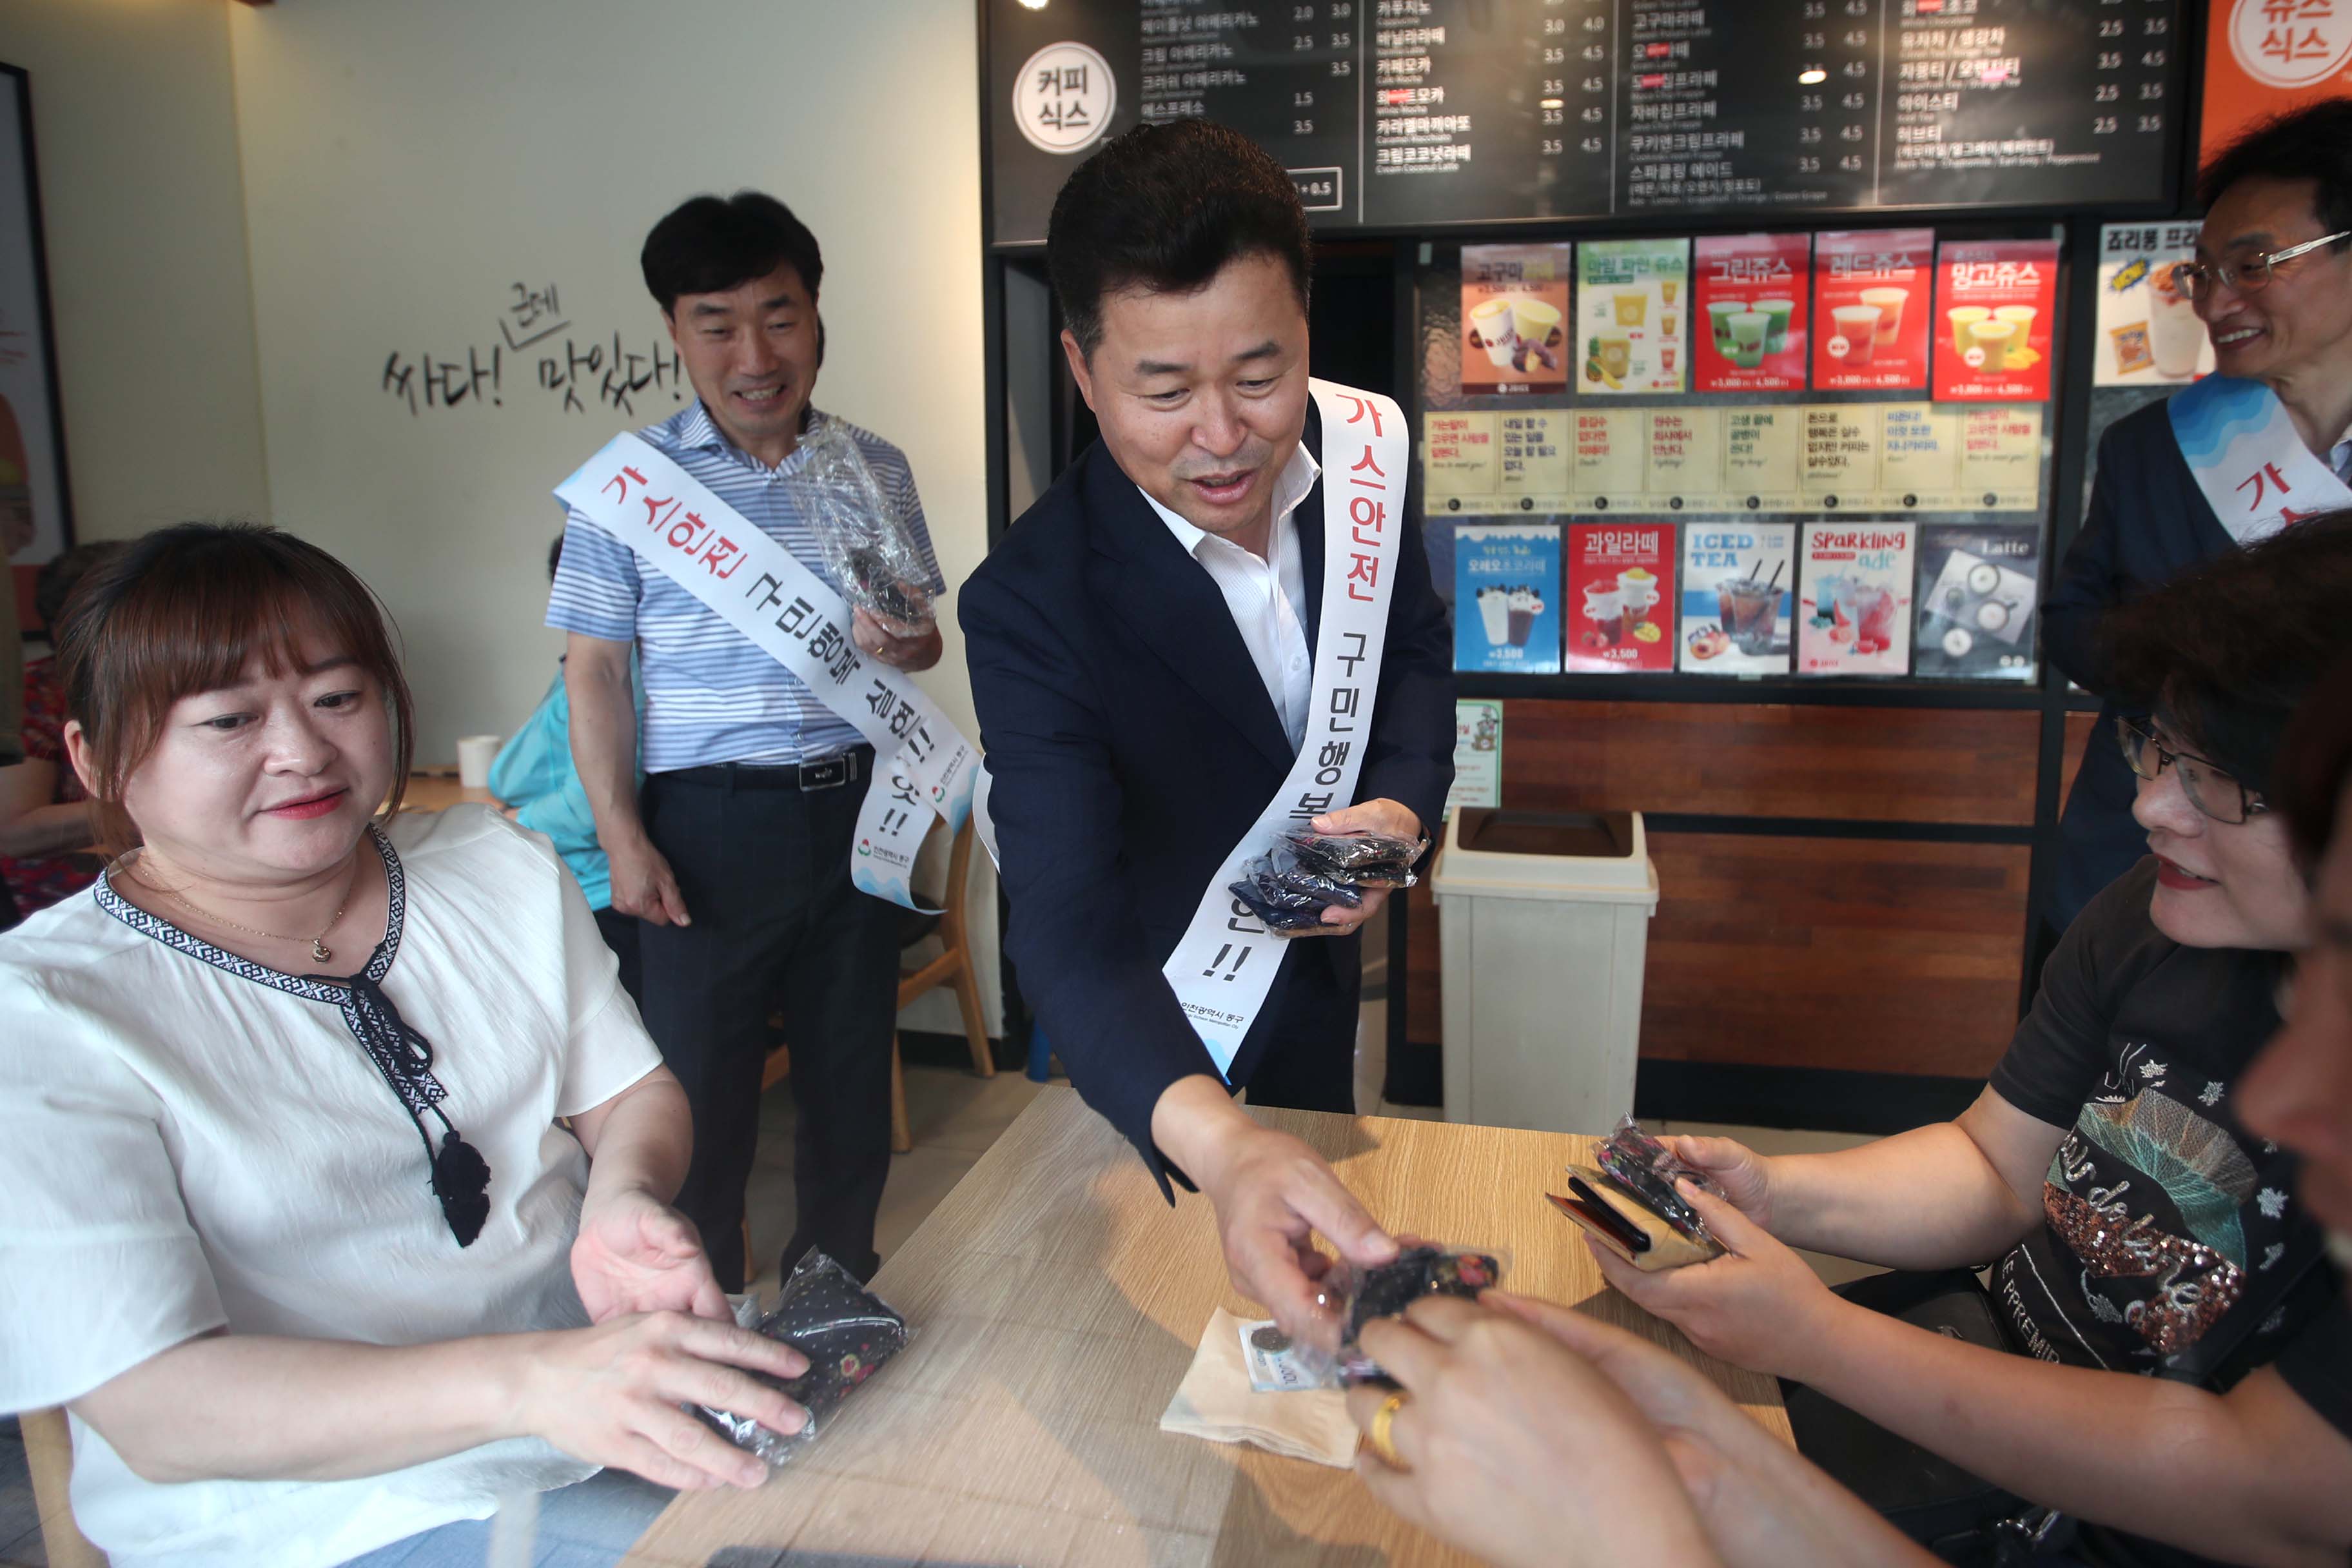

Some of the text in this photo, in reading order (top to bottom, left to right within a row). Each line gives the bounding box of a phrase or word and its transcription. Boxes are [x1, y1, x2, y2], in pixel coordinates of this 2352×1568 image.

[1805, 1, 1868, 18] 3.5 4.5
[2262, 0, 2333, 24] 쥬스
[1194, 13, 1259, 29] 아메리카노
[1544, 16, 1604, 35] 3.0 4.0
[1633, 9, 1705, 30] 고구마라떼
[2099, 17, 2168, 37] 2.5 3.5
[1293, 33, 1350, 51] 2.5 3.5
[1377, 27, 1445, 46] 바닐라라떼
[1804, 31, 1867, 50] 3.5 4.5
[2260, 28, 2330, 63] 식스
[1169, 43, 1233, 59] 아메리카노
[1544, 46, 1604, 63] 3.5 4.5
[2098, 50, 2165, 69] 3.5 4.5
[1331, 62, 1351, 77] 3.5
[1377, 57, 1431, 74] 카페모카
[1843, 61, 1866, 77] 4.5
[1038, 64, 1088, 97] 커피
[1182, 70, 1247, 86] 아메리카노
[1543, 77, 1603, 95] 3.5 4.5
[1295, 92, 1313, 106] 1.5
[2095, 83, 2163, 101] 2.5 3.5
[1141, 101, 1205, 117] 에스프레소
[1801, 93, 1865, 112] 3.5 4.5
[1897, 92, 1959, 112] 아이스티
[1039, 101, 1090, 130] 식스
[1542, 107, 1602, 126] 3.5 4.5
[2093, 115, 2161, 133] 2.5 3.5
[1295, 120, 1313, 135] 3.5
[1800, 125, 1863, 144] 3.5 4.5
[1897, 124, 1941, 142] 허브티
[1377, 144, 1471, 164] 크림코코넛라떼
[1542, 137, 1602, 155] 3.5 4.5
[1630, 162, 1733, 181] 스파클링 에이드
[1799, 155, 1862, 173] 3.5 4.5
[1709, 257, 1794, 284] 그린쥬스
[1830, 252, 1916, 280] 레드쥬스
[1951, 262, 2041, 291] 망고쥬스
[382, 329, 681, 417] 싸다! 맛있다!
[1808, 427, 1837, 438] 행복은
[1841, 441, 1869, 452] 커피는
[1335, 394, 1386, 602] 가스안전
[1584, 531, 1659, 556] 과일라떼
[1692, 534, 1754, 549] ICED
[1982, 539, 2030, 556] Latte
[1690, 552, 1738, 567] TEA
[601, 465, 749, 579] 가스안전
[745, 573, 861, 686] 구민행복
[1181, 1001, 1244, 1024] 인천광역시 동구
